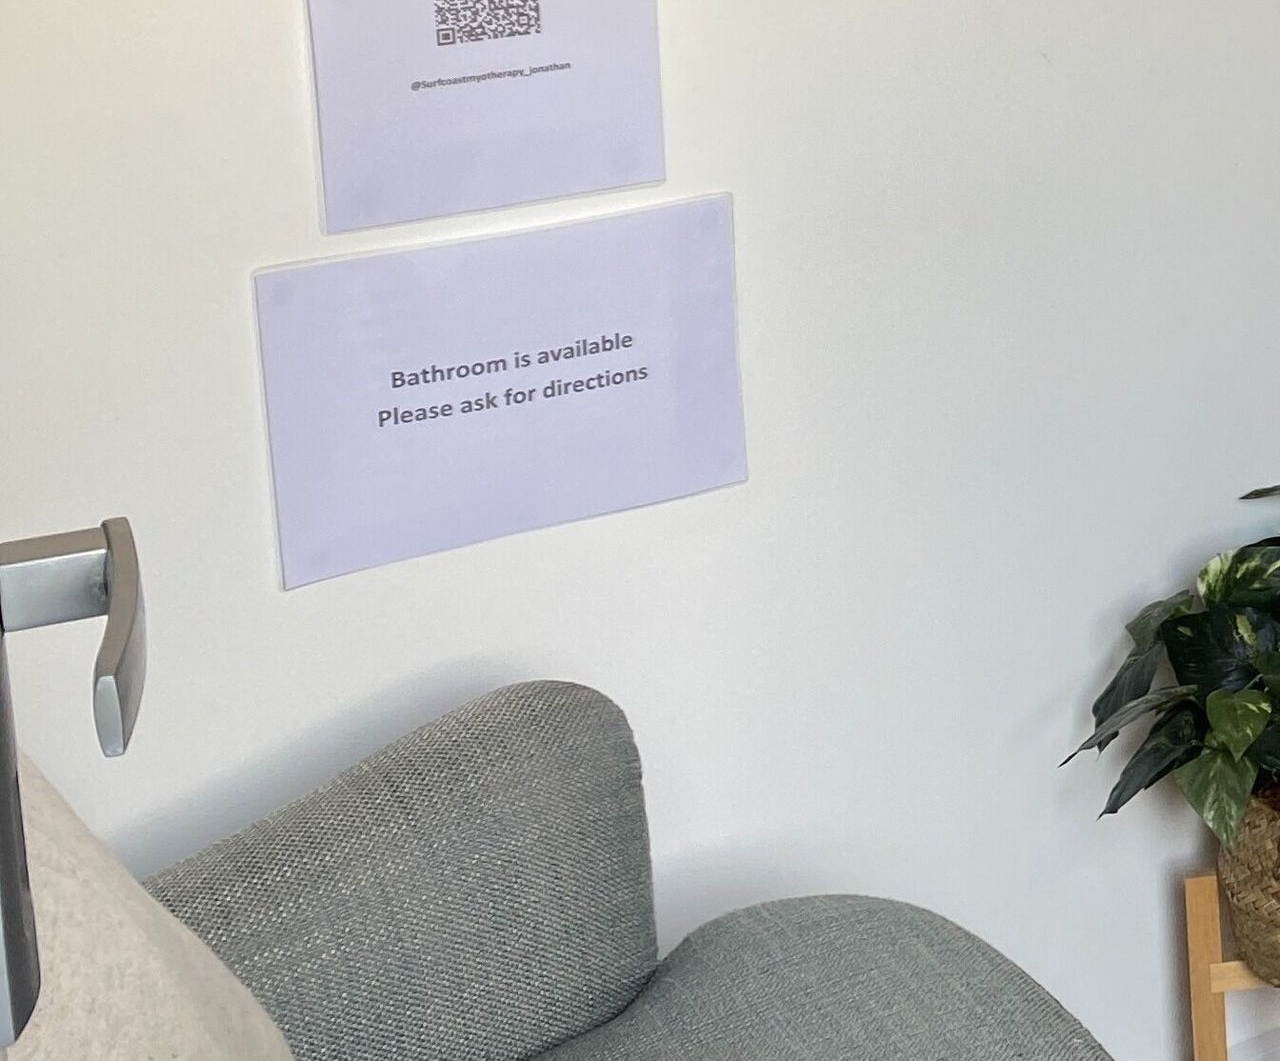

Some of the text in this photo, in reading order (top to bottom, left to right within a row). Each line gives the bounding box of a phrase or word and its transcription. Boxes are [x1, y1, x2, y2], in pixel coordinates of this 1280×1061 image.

[390, 332, 633, 388] Bathroom is available
[378, 364, 649, 427] Please ask for directions
